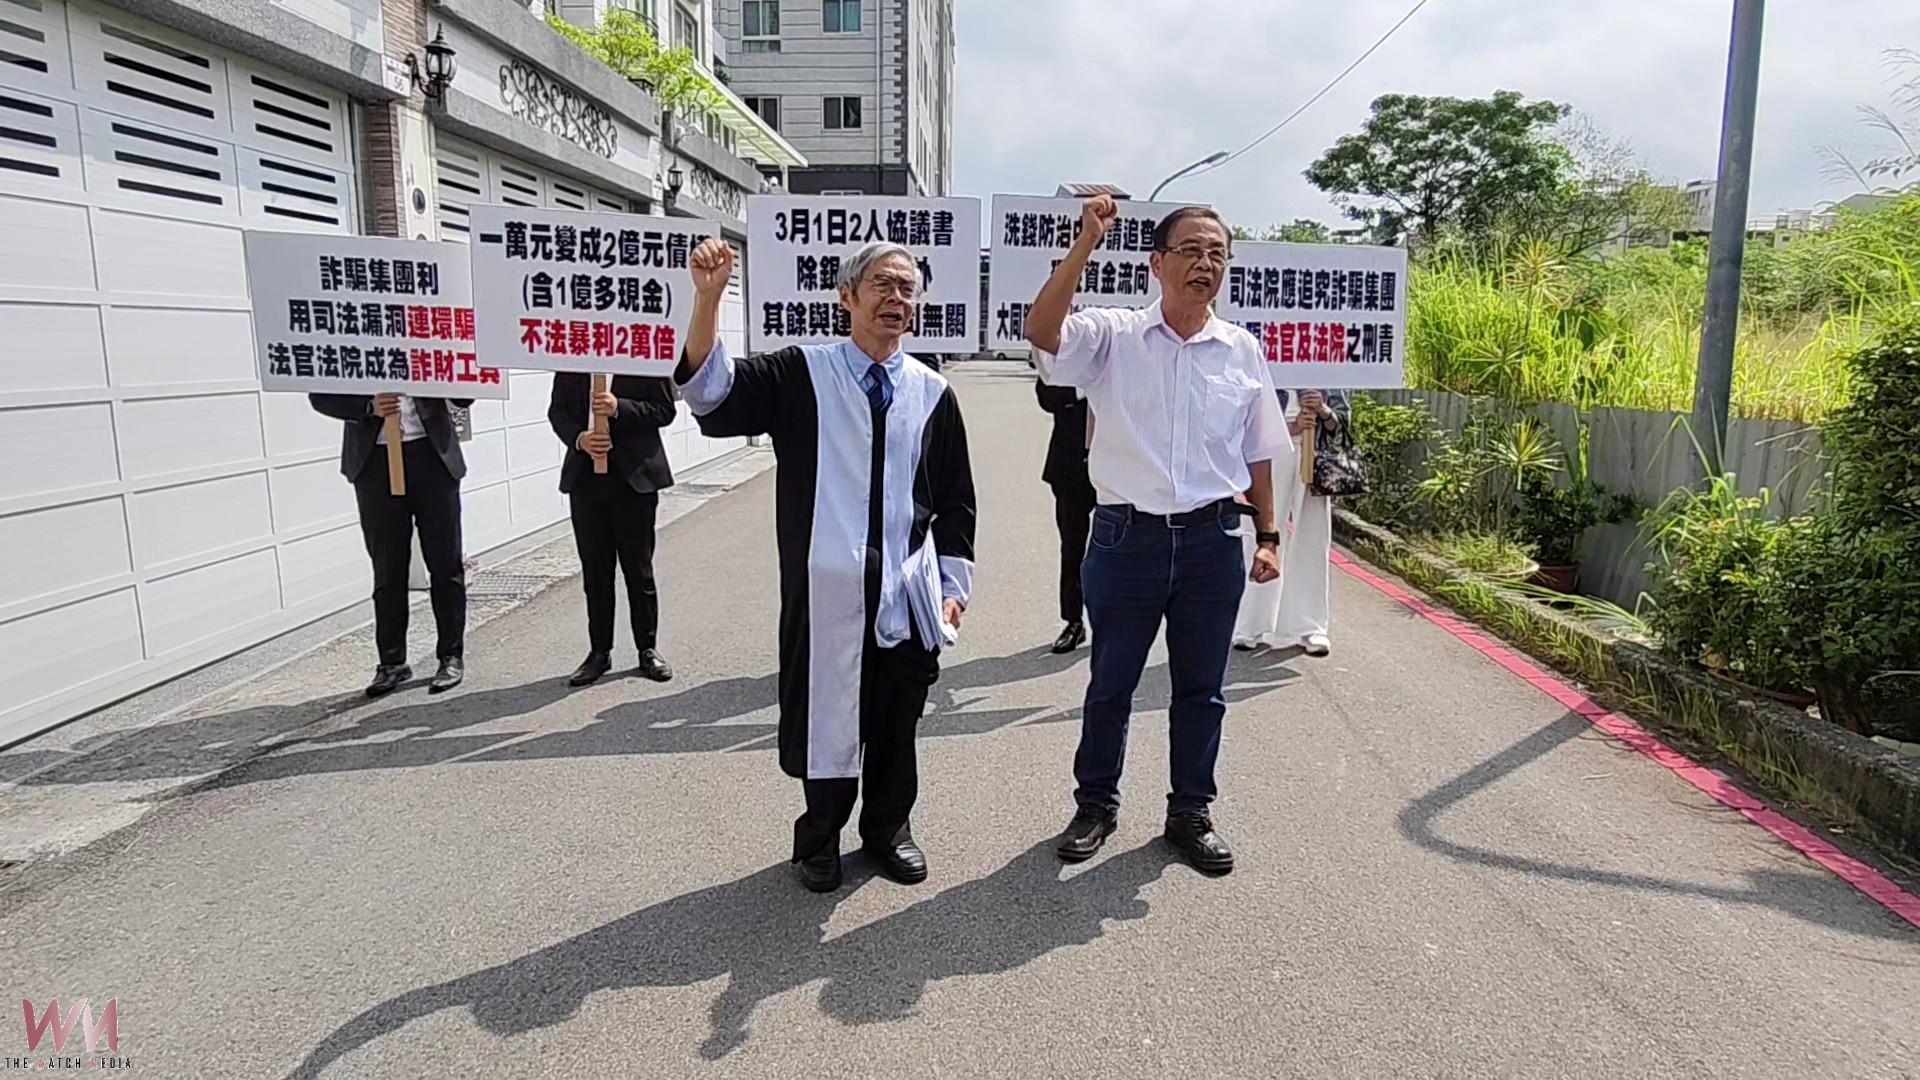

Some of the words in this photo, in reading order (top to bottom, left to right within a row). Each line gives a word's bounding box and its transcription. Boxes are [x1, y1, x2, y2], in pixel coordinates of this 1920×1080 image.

[480, 221, 712, 269] 一萬元變成2億元債
[775, 208, 954, 247] 3月1日2人協議書
[1004, 211, 1156, 252] 洗錢防治請追查
[319, 255, 439, 295] 詐騙集團利
[522, 271, 673, 318] (含1億多現金)
[1051, 259, 1150, 296] 資金流向
[1229, 266, 1397, 312] 司法院應追究詐騙集團
[288, 299, 475, 341] 用司法漏洞連環騙
[519, 318, 676, 361] 不法暴利2萬倍
[763, 301, 966, 338] 其餘與建無關
[1229, 320, 1394, 364] 法官及法院之刑責
